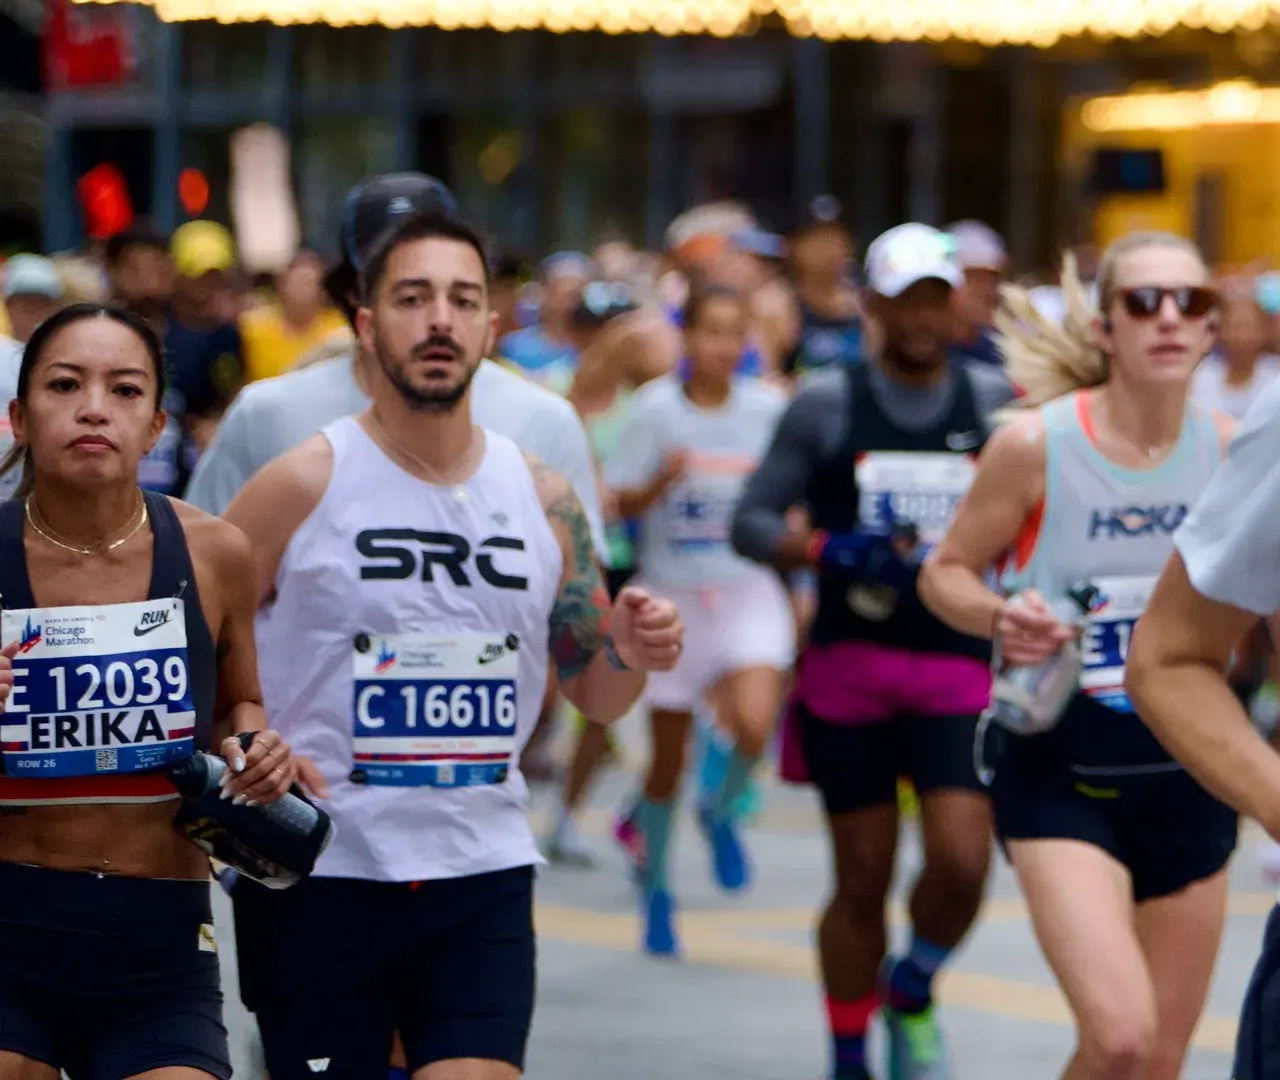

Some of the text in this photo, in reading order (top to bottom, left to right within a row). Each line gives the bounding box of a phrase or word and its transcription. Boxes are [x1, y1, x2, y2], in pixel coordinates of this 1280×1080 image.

[355, 528, 528, 590] SRC
[45, 625, 86, 637] Chicago
[140, 609, 170, 625] RUN
[46, 636, 95, 647] Marathon
[1082, 622, 1107, 665] E
[5, 656, 188, 713] E 12039
[357, 684, 517, 729] C 16616
[31, 709, 167, 750] ERIKA
[17, 758, 56, 769] ROW 26
